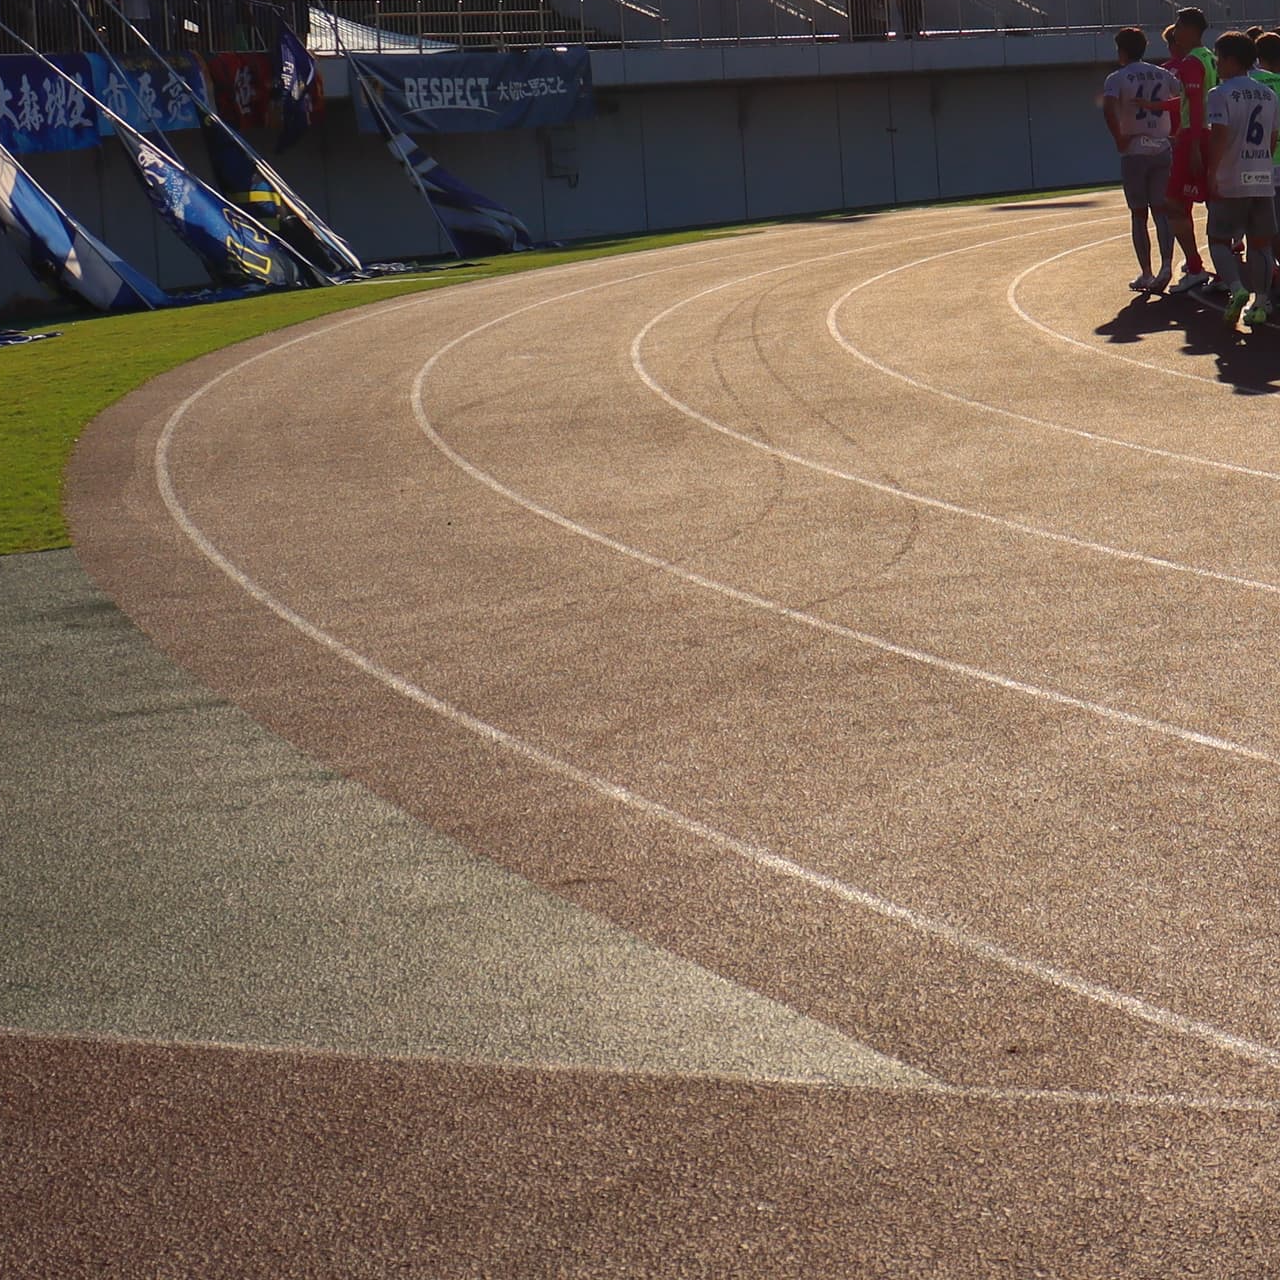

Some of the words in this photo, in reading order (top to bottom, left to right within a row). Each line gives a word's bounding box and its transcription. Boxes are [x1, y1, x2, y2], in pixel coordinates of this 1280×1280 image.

[404, 77, 490, 109] RESPECT
[496, 76, 568, 102] 大切に思うこと
[1246, 104, 1265, 146] 6
